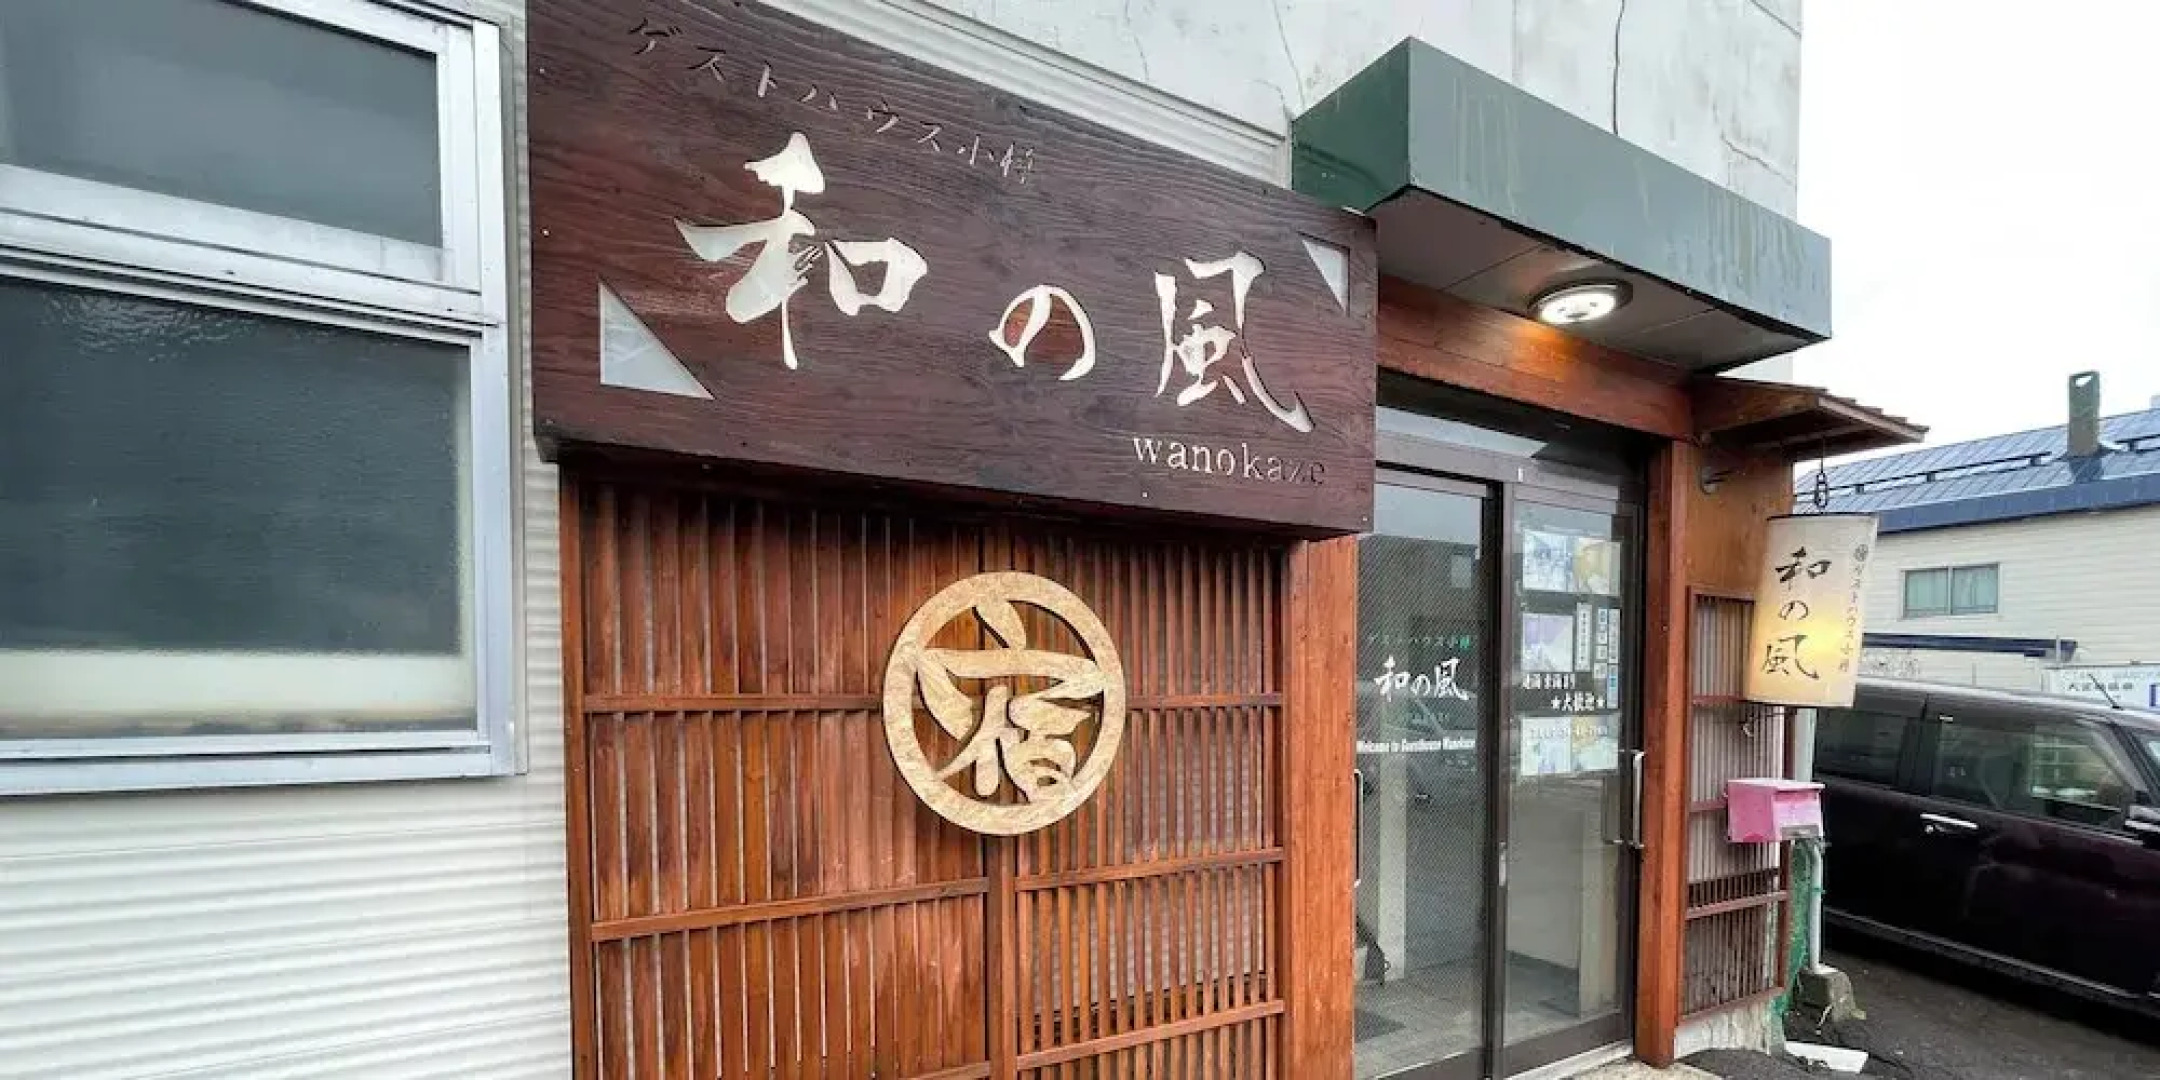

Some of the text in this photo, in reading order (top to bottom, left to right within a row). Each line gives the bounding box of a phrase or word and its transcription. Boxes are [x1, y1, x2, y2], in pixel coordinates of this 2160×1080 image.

[628, 18, 1034, 184] ゲストハウス小樽
[674, 132, 1313, 433] 和の風
[1133, 436, 1325, 486] wanokaze
[1374, 655, 1469, 702] 和の風
[1761, 546, 1832, 680] 和の風
